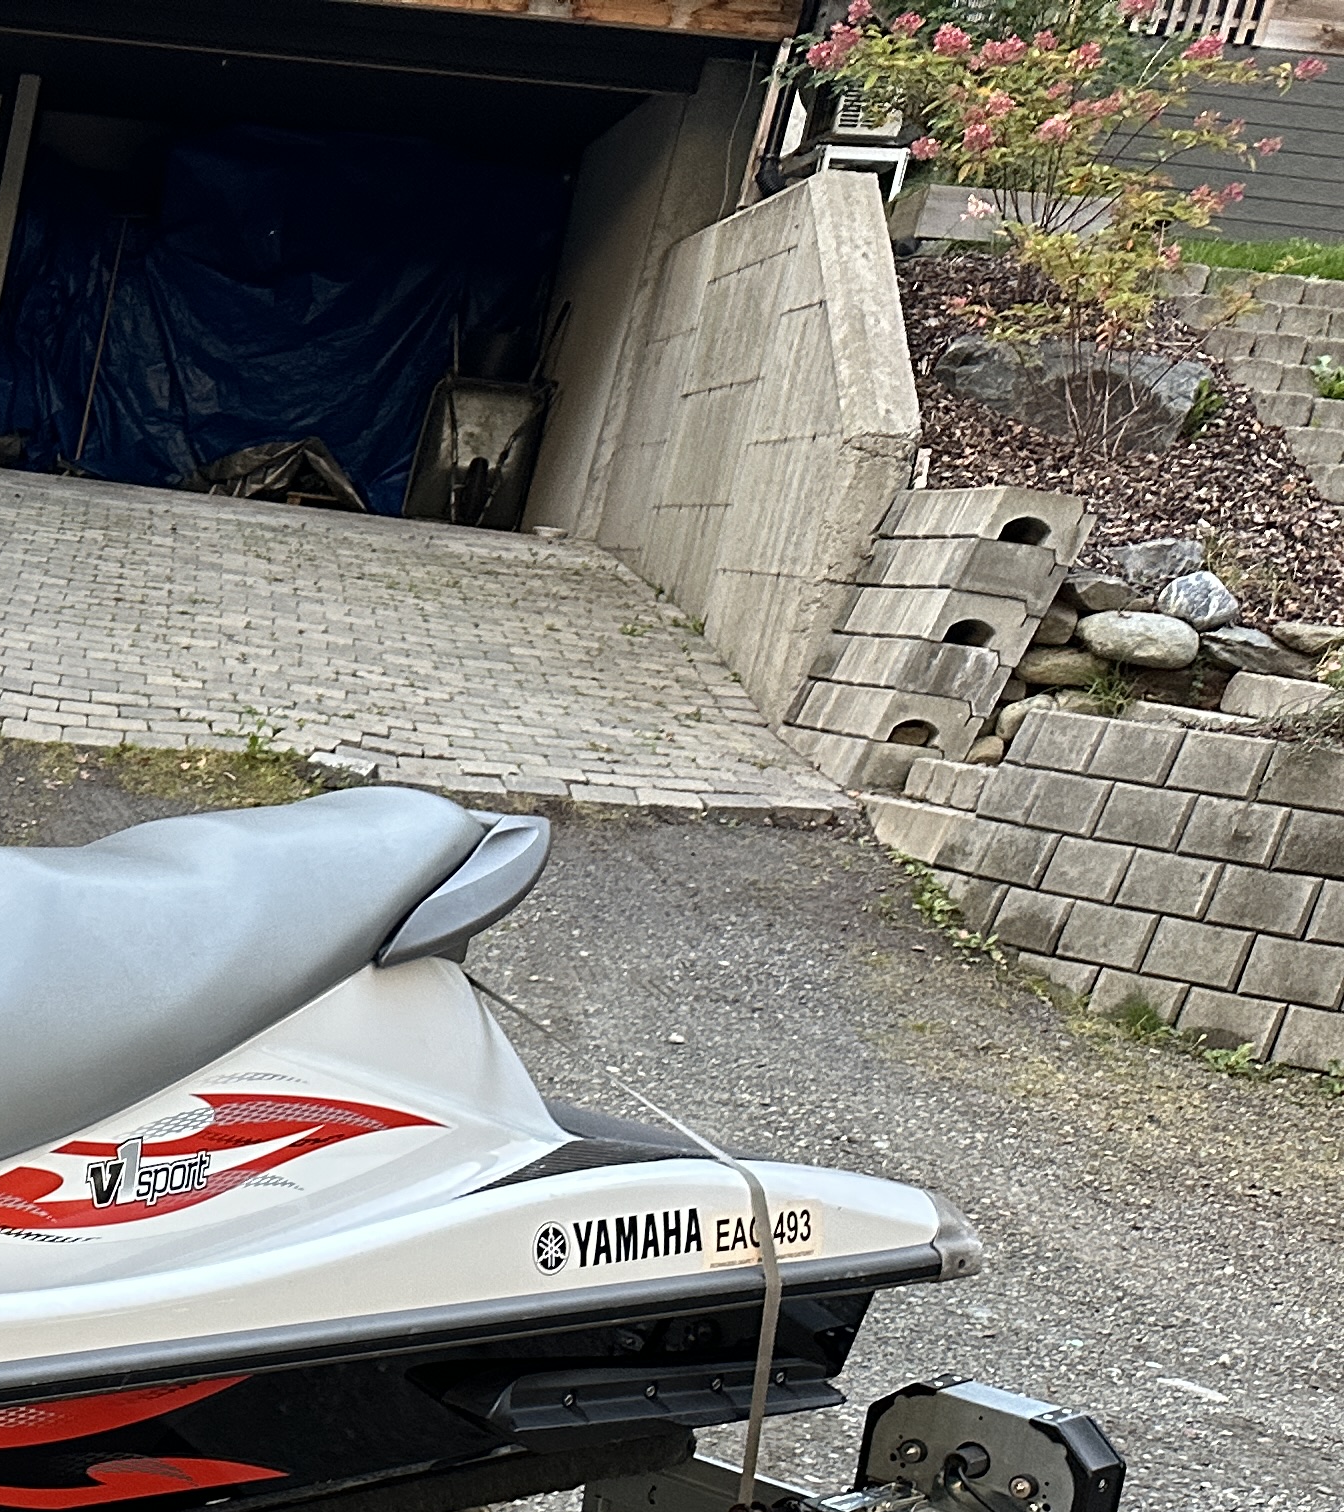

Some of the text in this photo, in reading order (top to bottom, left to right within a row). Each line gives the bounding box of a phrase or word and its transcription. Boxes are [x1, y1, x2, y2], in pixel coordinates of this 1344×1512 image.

[136, 1151, 210, 1205] sport
[572, 1207, 702, 1268] YAMAHA
[773, 1209, 812, 1245] 493
